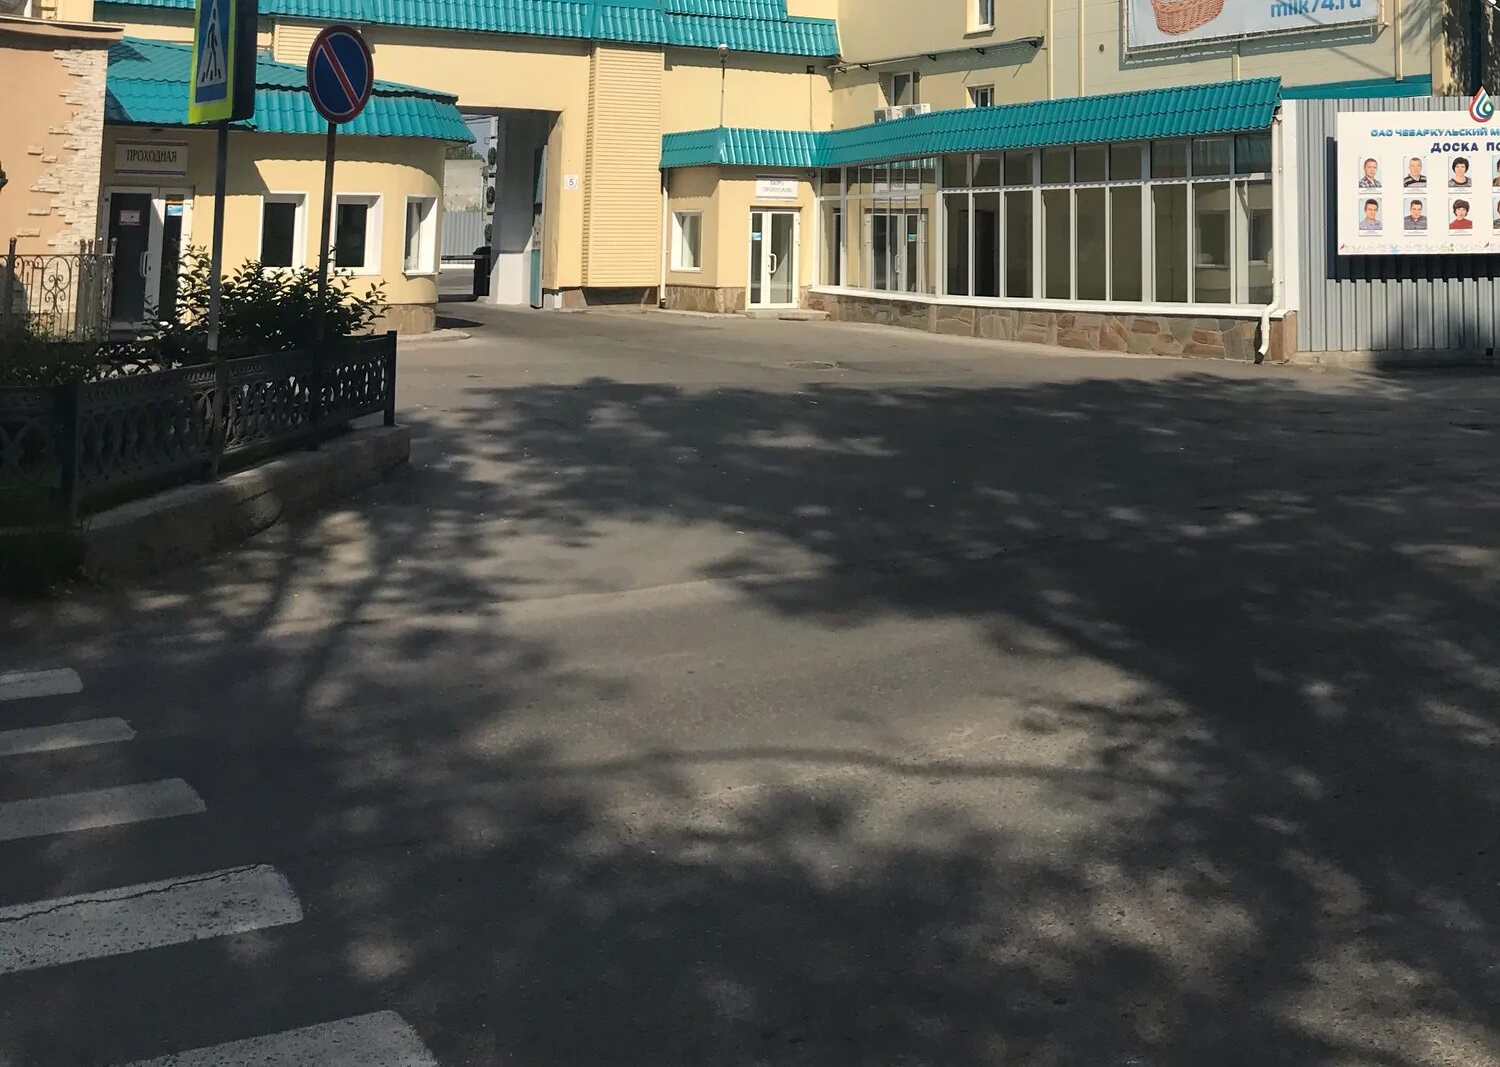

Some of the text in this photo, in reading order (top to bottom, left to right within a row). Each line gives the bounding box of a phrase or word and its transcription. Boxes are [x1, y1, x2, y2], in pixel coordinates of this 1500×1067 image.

[1370, 129, 1393, 137] ОАО
[1395, 127, 1488, 137] ЧЕБАРКУЛЬСКИЙ
[1430, 142, 1479, 154] ДОСКА
[126, 149, 177, 162] ПРОХОДНАЯ
